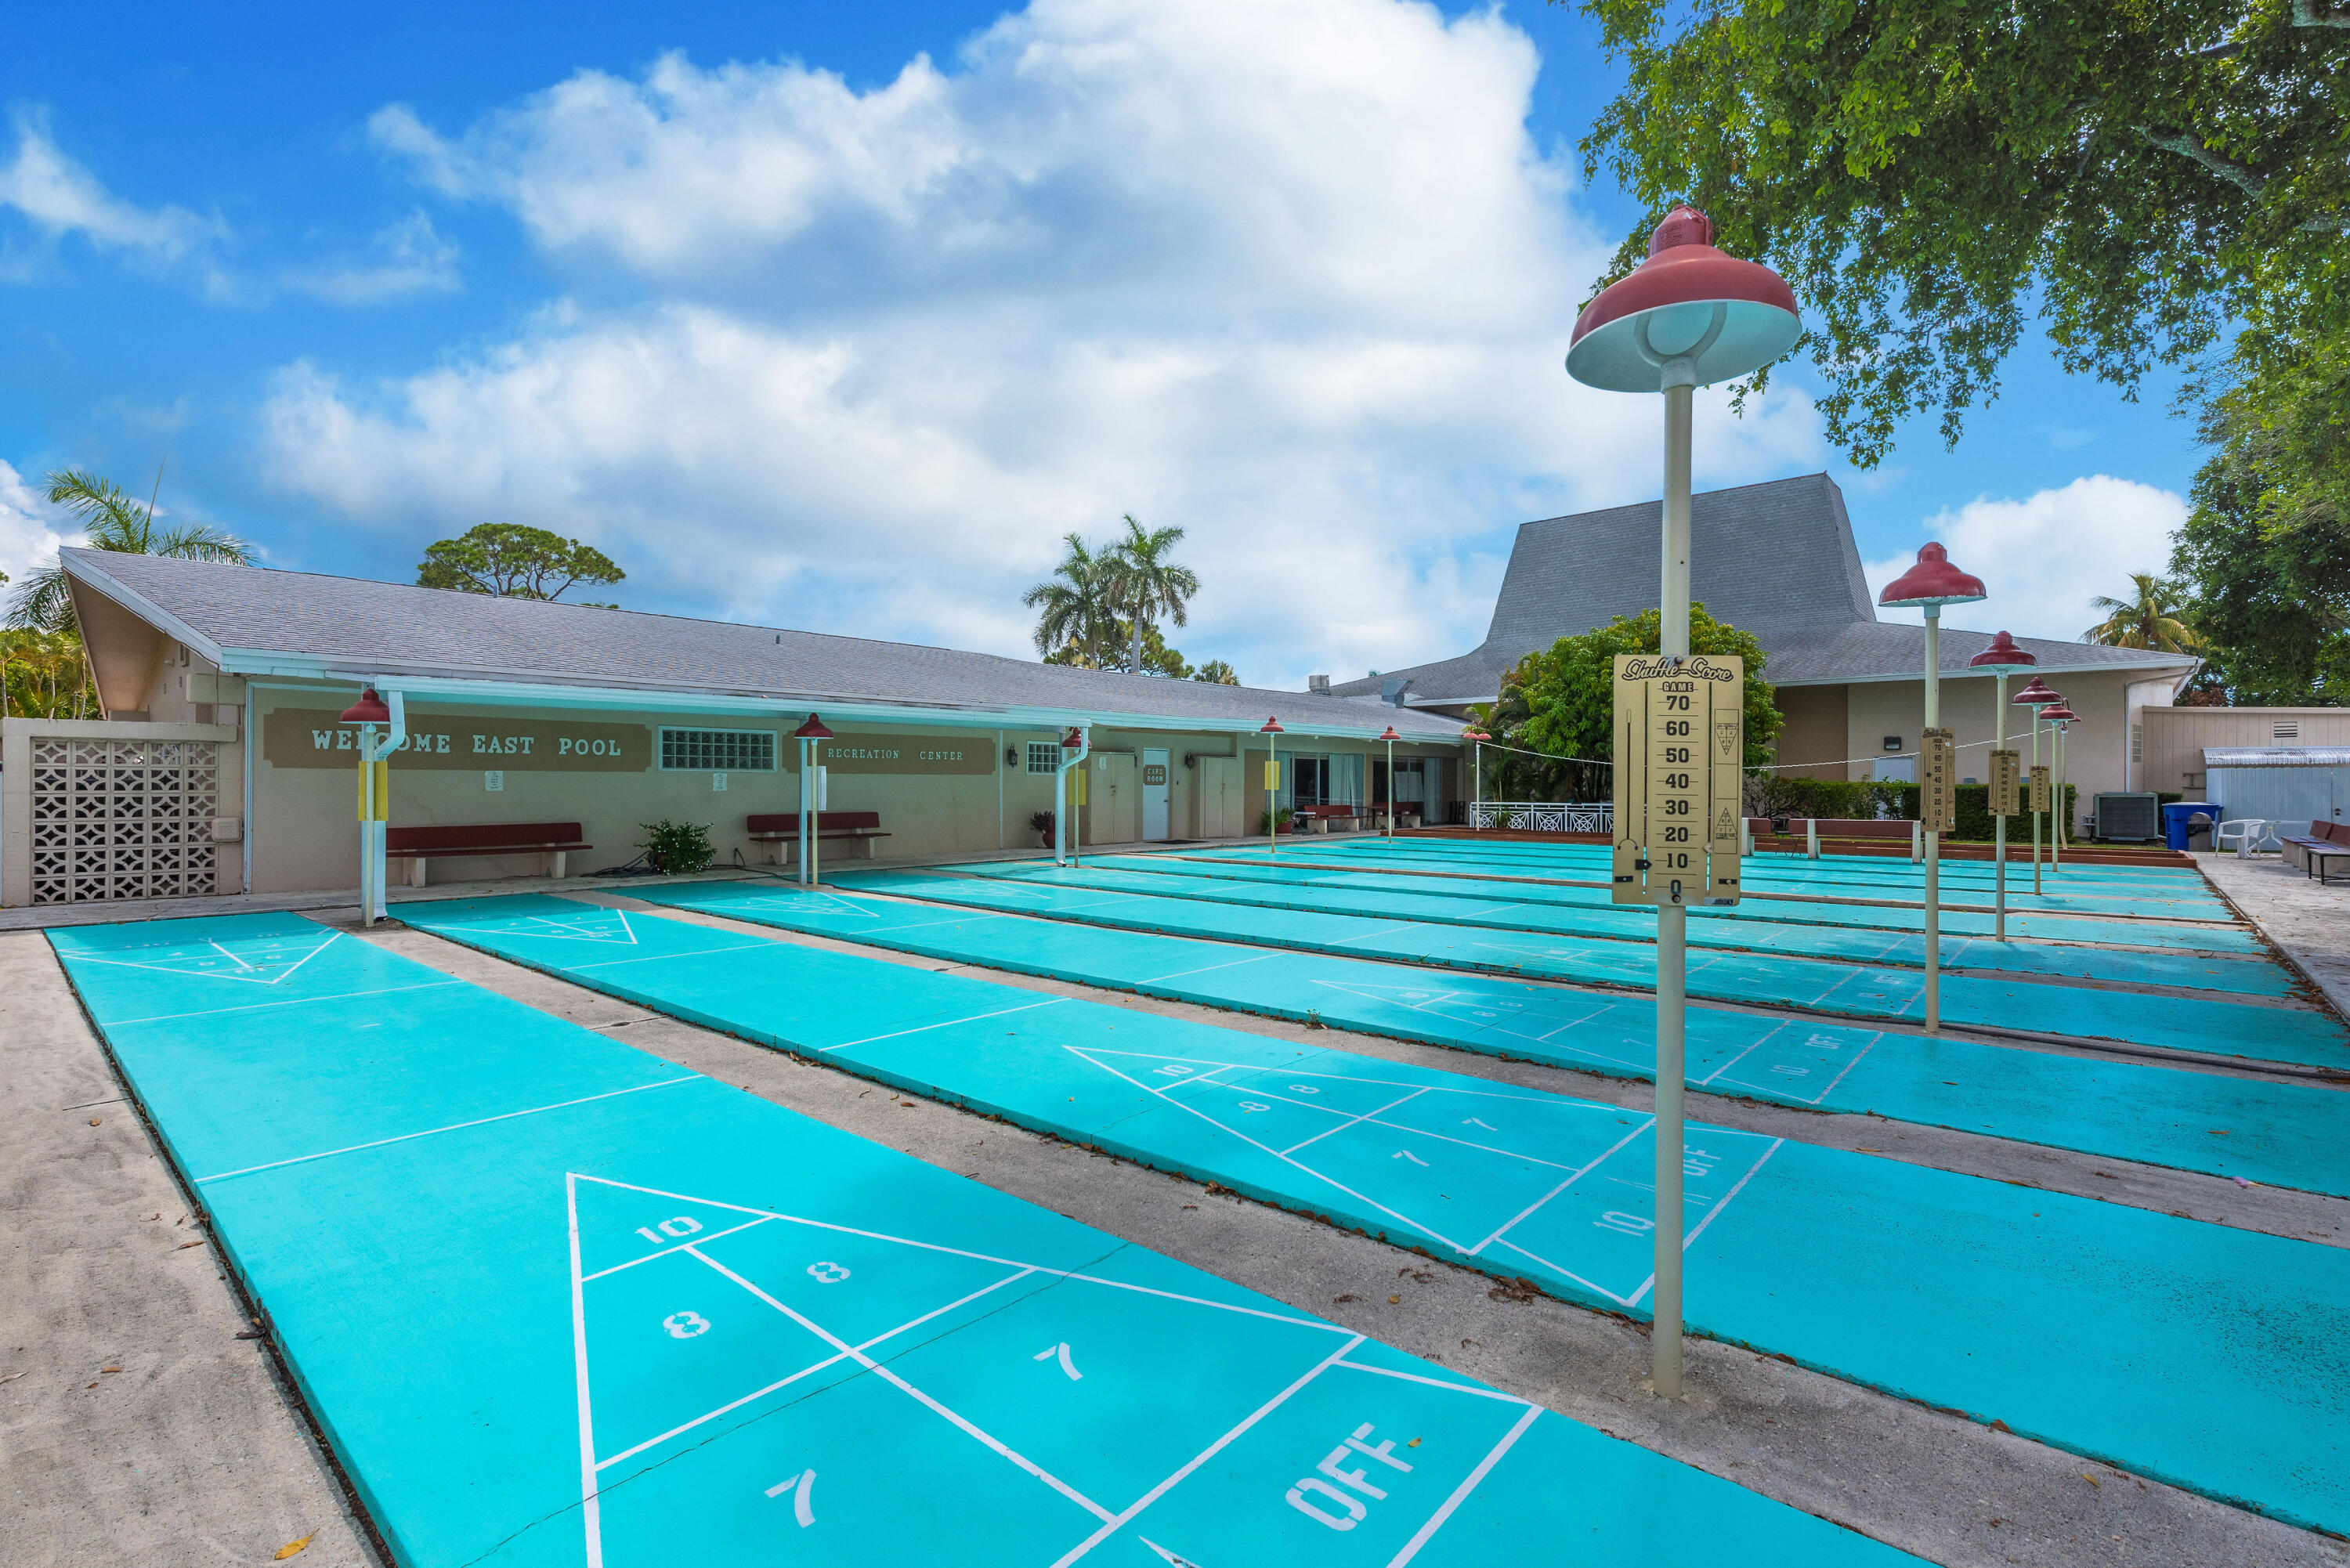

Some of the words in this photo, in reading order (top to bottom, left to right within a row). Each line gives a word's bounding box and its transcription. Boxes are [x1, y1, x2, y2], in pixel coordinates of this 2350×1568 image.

[1622, 656, 1734, 681] Shuffle-Score
[1662, 681, 1694, 692] GAME
[1666, 695, 1690, 710] 70
[1666, 721, 1690, 736] 60
[472, 735, 534, 754] EAST
[559, 738, 621, 756] POOL
[827, 748, 899, 760] RECREATION
[920, 750, 963, 761] CENTER
[1665, 747, 1690, 764] 50
[1665, 773, 1689, 789] 40
[1665, 800, 1689, 815] 30
[1665, 826, 1689, 843] 20
[1667, 853, 1688, 869] 10
[1670, 879, 1682, 896] 0
[1152, 1064, 1194, 1077] 10
[1289, 1084, 1320, 1094] 8
[1238, 1101, 1271, 1112] 8
[1461, 1117, 1499, 1132] 7
[1390, 1149, 1430, 1167] 7
[634, 1215, 705, 1245] 10
[1593, 1211, 1655, 1237] 10
[806, 1261, 851, 1284] 8
[663, 1310, 711, 1339] 8
[1032, 1342, 1083, 1382] 7
[1285, 1422, 1415, 1532] OFF
[764, 1468, 818, 1529] 7
